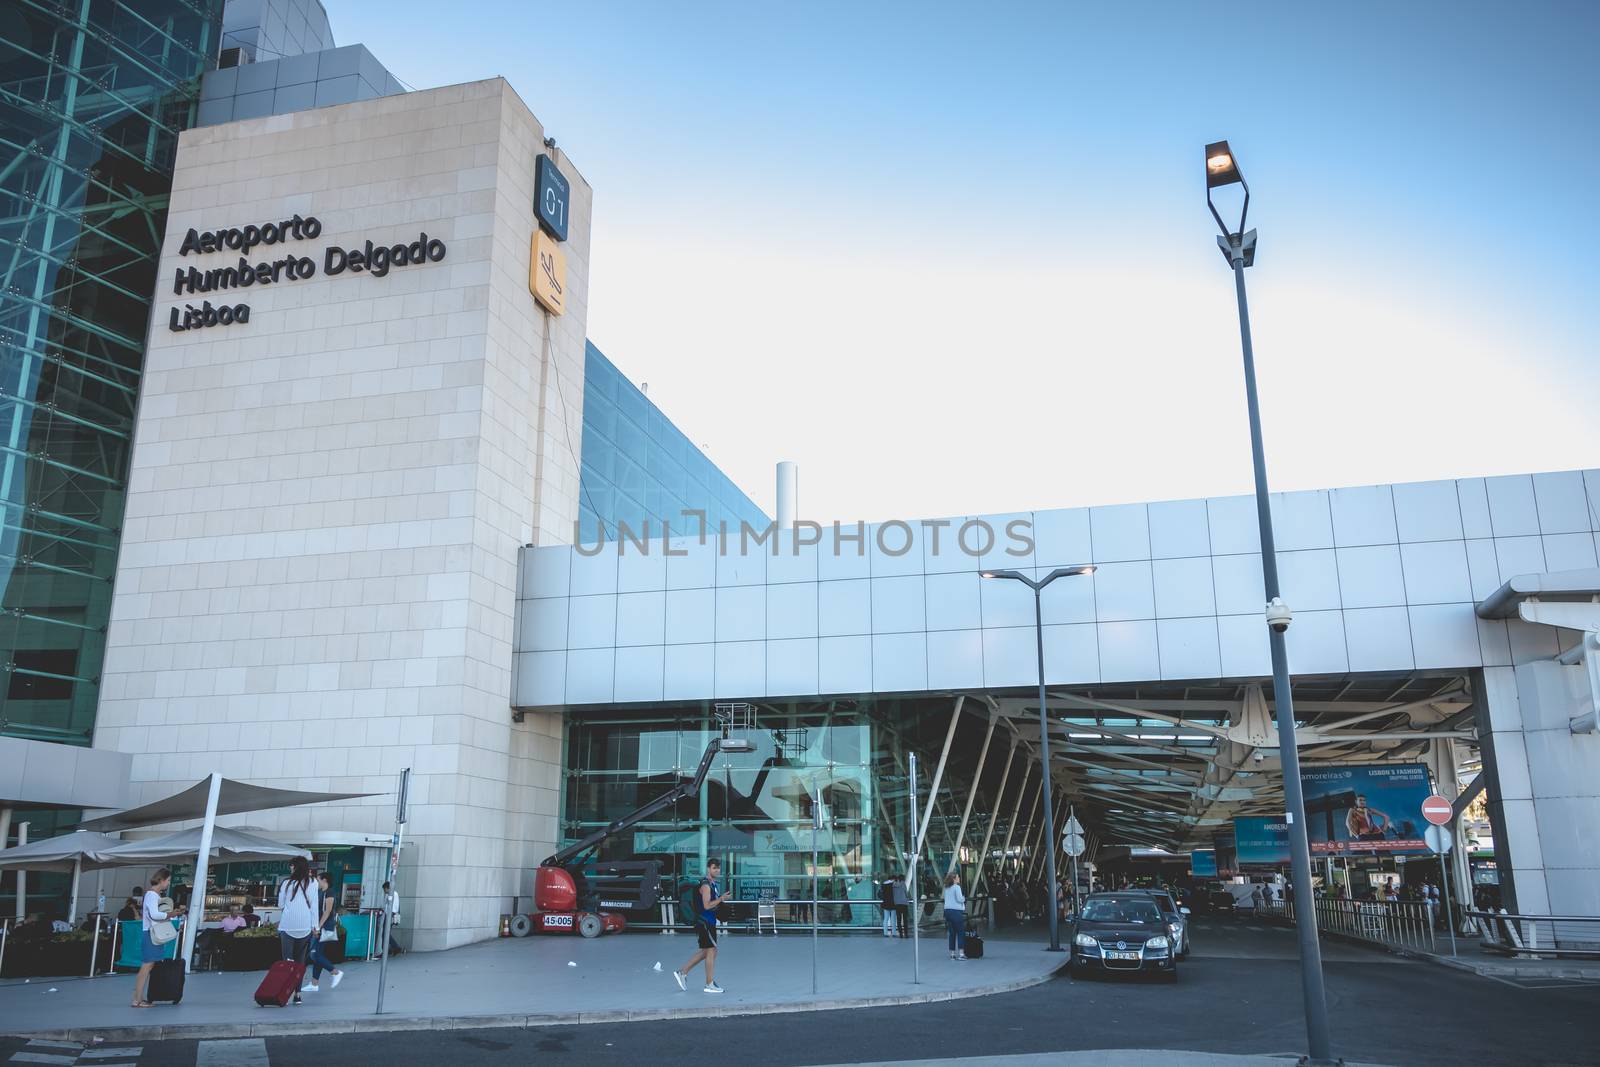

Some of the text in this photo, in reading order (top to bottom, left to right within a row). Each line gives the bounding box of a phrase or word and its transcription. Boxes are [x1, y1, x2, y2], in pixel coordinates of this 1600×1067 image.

[546, 187, 564, 226] 01
[179, 214, 322, 256] Aeroporto
[173, 232, 447, 295] Humberto Delgado
[169, 301, 250, 332] Lisboa
[1301, 772, 1343, 780] amoreiras
